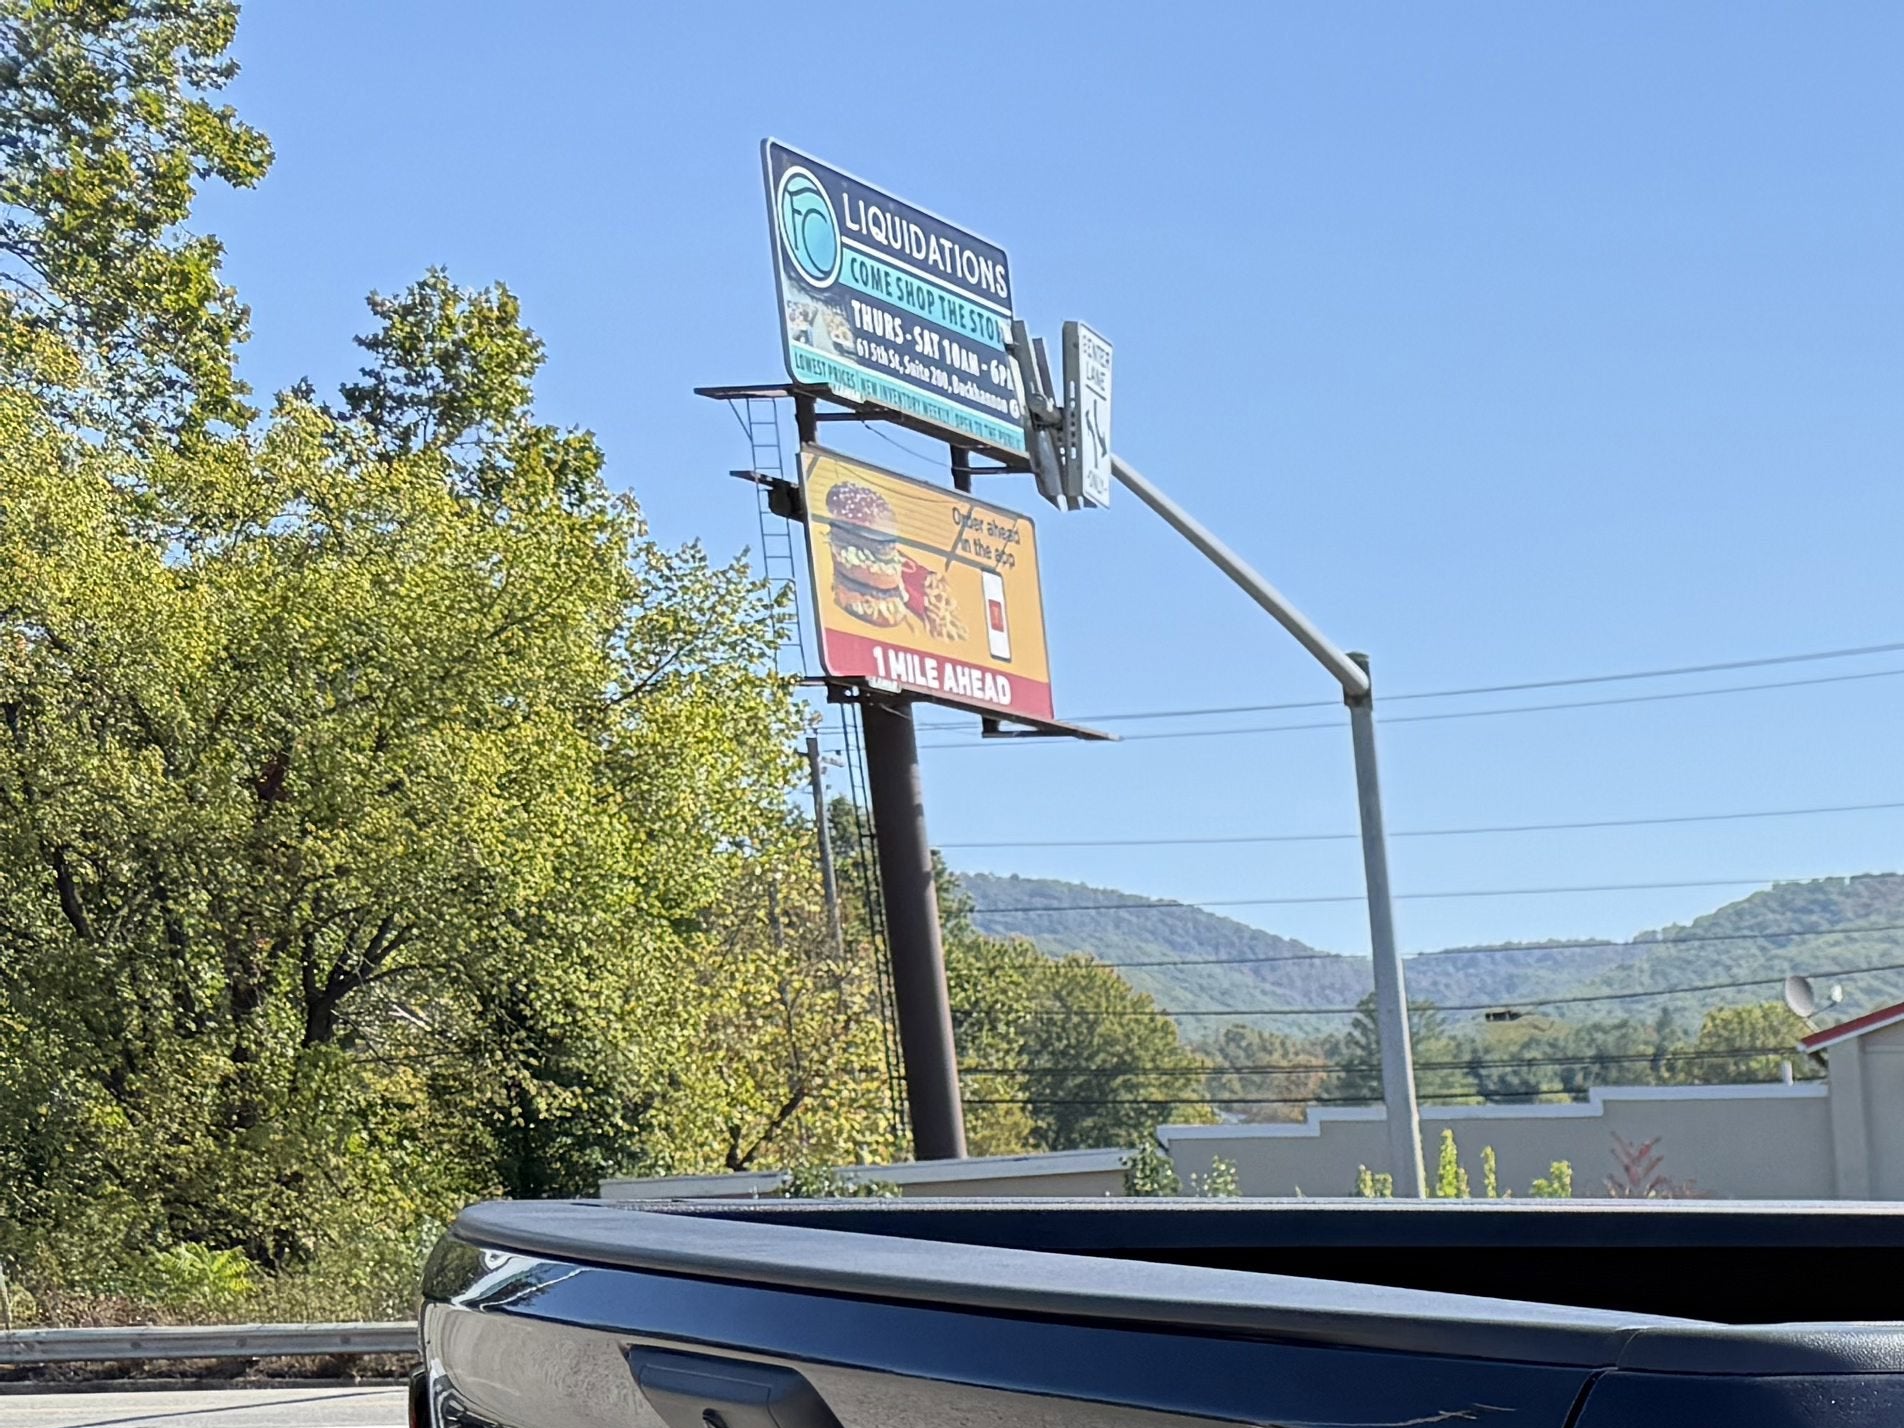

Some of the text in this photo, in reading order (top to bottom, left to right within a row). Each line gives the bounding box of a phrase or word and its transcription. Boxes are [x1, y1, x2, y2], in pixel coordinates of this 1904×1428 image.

[842, 192, 1008, 298] LIQUIDATIONS
[850, 257, 893, 297] COME
[896, 277, 934, 314] SHOP
[939, 293, 967, 329] THE
[851, 299, 904, 344] THURS
[913, 326, 940, 360] SAT
[942, 338, 980, 376] 10AM
[795, 353, 826, 377] LOWEST
[828, 363, 856, 389] PRICES
[860, 377, 879, 399] NEW
[881, 382, 921, 415] INVENTORY
[870, 342, 888, 367] 5th
[904, 355, 930, 382] Suite
[952, 372, 1008, 414] Buckhannon
[952, 507, 1020, 544] Order ahead
[973, 540, 992, 560] the
[994, 549, 1015, 571] app
[872, 646, 886, 677] 1
[888, 648, 940, 689] MILE
[943, 662, 1011, 705] AHEAD
